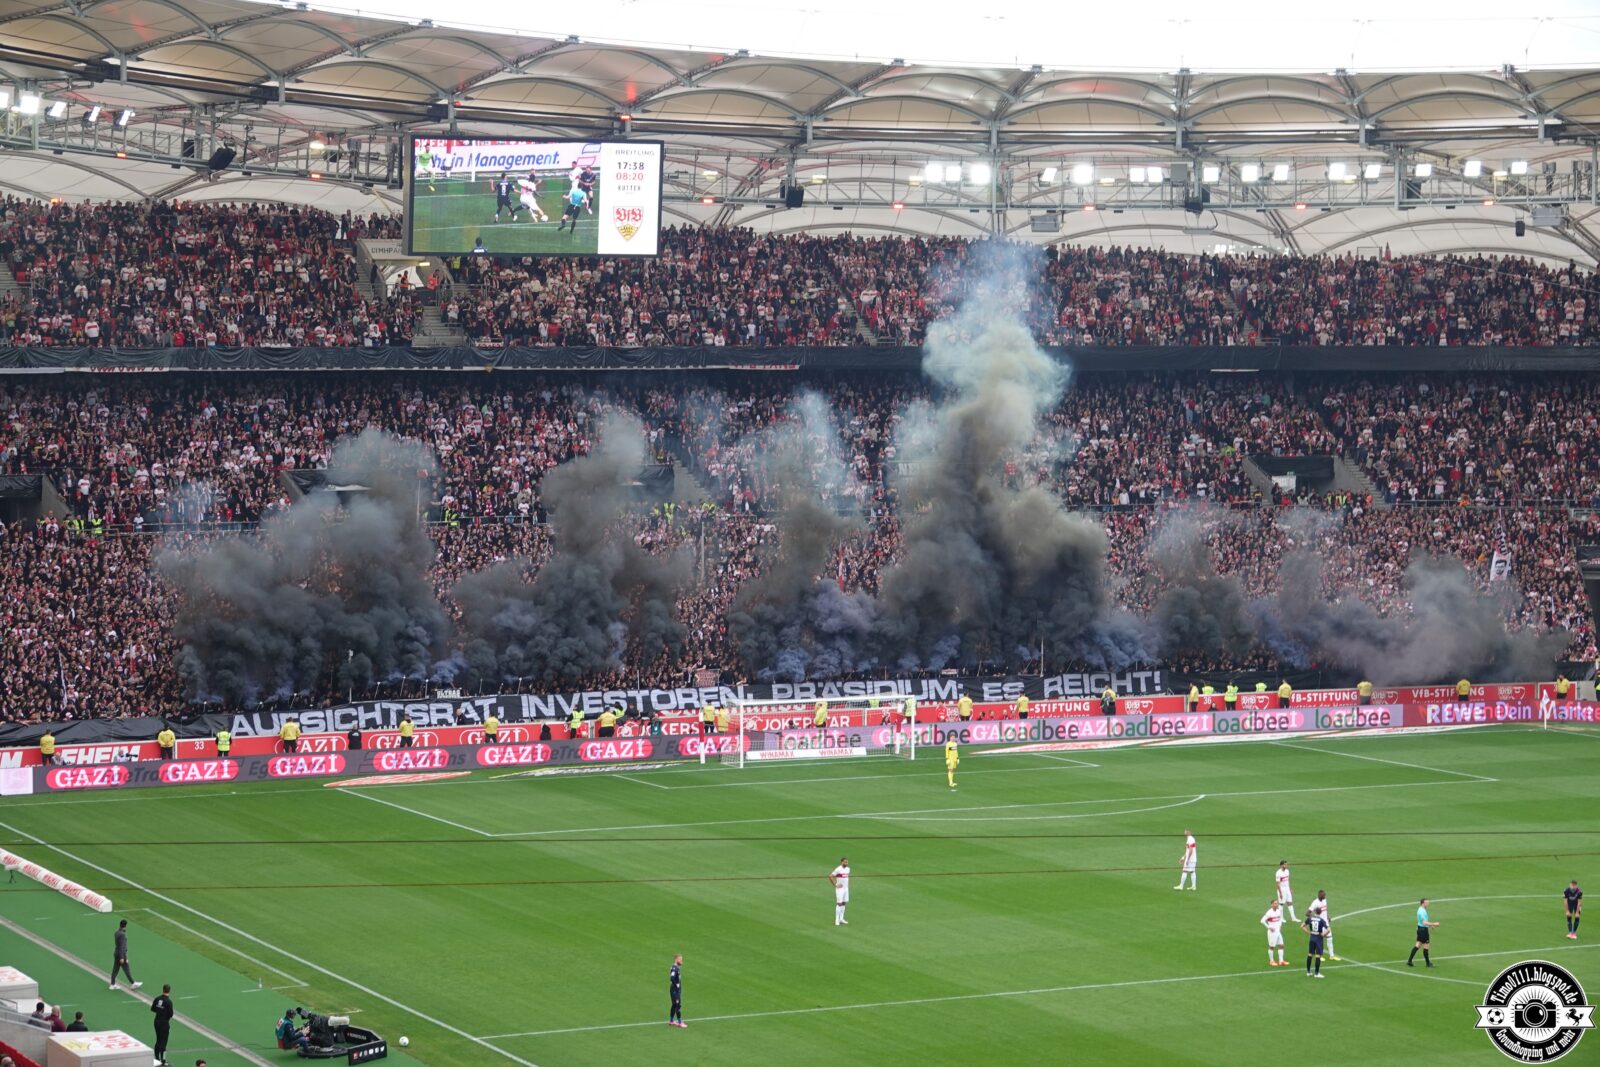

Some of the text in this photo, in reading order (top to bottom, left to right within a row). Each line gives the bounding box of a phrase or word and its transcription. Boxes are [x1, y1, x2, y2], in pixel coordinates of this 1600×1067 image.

[617, 161, 645, 170] 17:38
[615, 172, 644, 181] 08:20
[982, 682, 1025, 701] ES
[1044, 671, 1161, 700] REICHT!
[1291, 692, 1358, 703] fB-STIFTUNG
[1412, 687, 1485, 698] VfB-STIFNG
[1203, 695, 1212, 705] 36
[1009, 702, 1090, 714] V-STIFTUNG
[1426, 702, 1486, 724] REWE
[1496, 700, 1532, 721] Dein
[1107, 715, 1186, 738] loadbee
[1212, 711, 1290, 734] loadbee
[998, 719, 1080, 743] loadbee
[194, 740, 205, 752] 33
